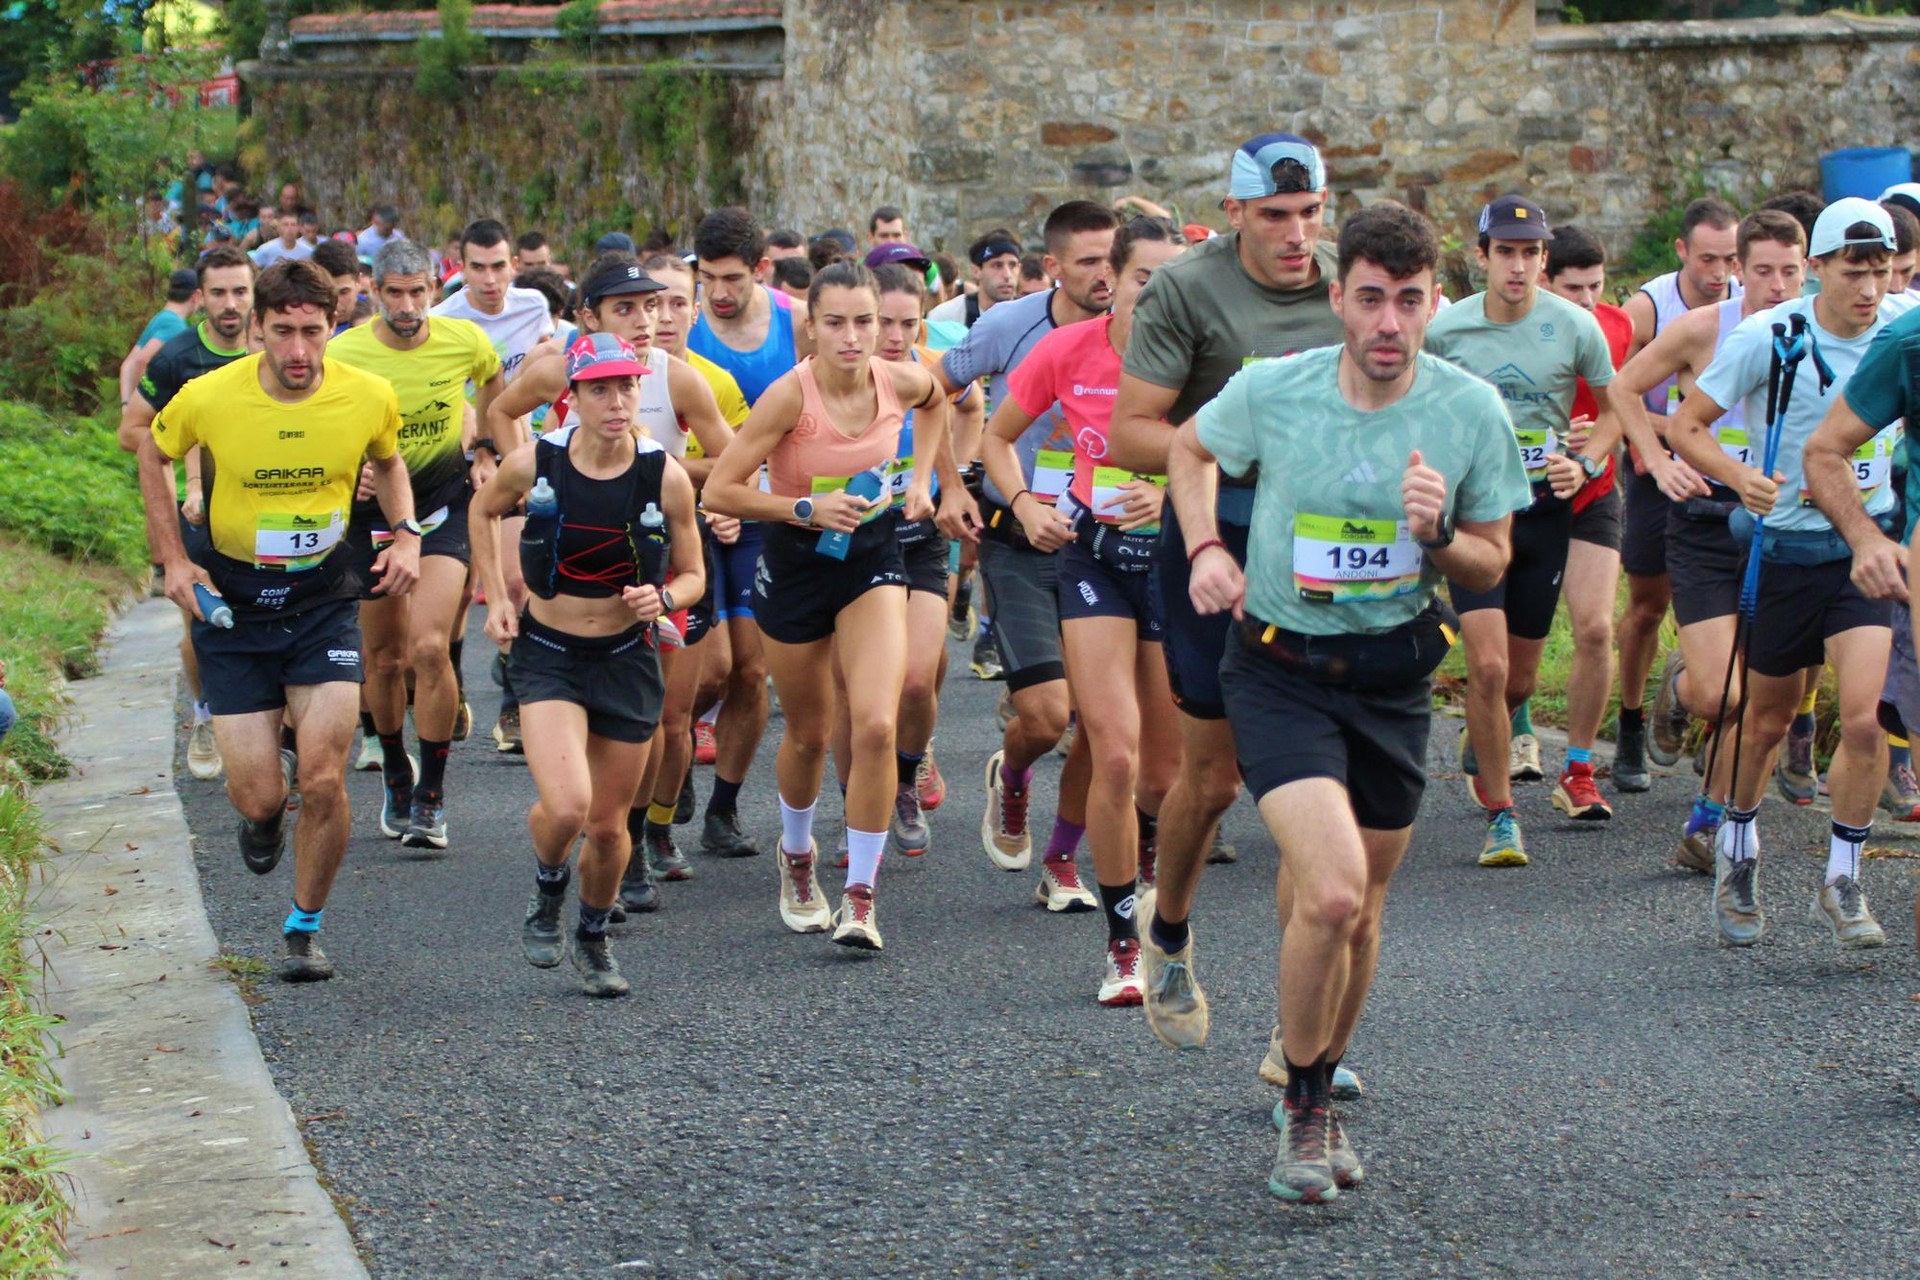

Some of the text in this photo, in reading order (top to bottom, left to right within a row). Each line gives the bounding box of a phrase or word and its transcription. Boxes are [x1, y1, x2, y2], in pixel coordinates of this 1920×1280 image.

[290, 532, 319, 549] 13
[1326, 546, 1390, 569] 194
[1334, 569, 1379, 579] ANDONI
[260, 586, 292, 597] COMP
